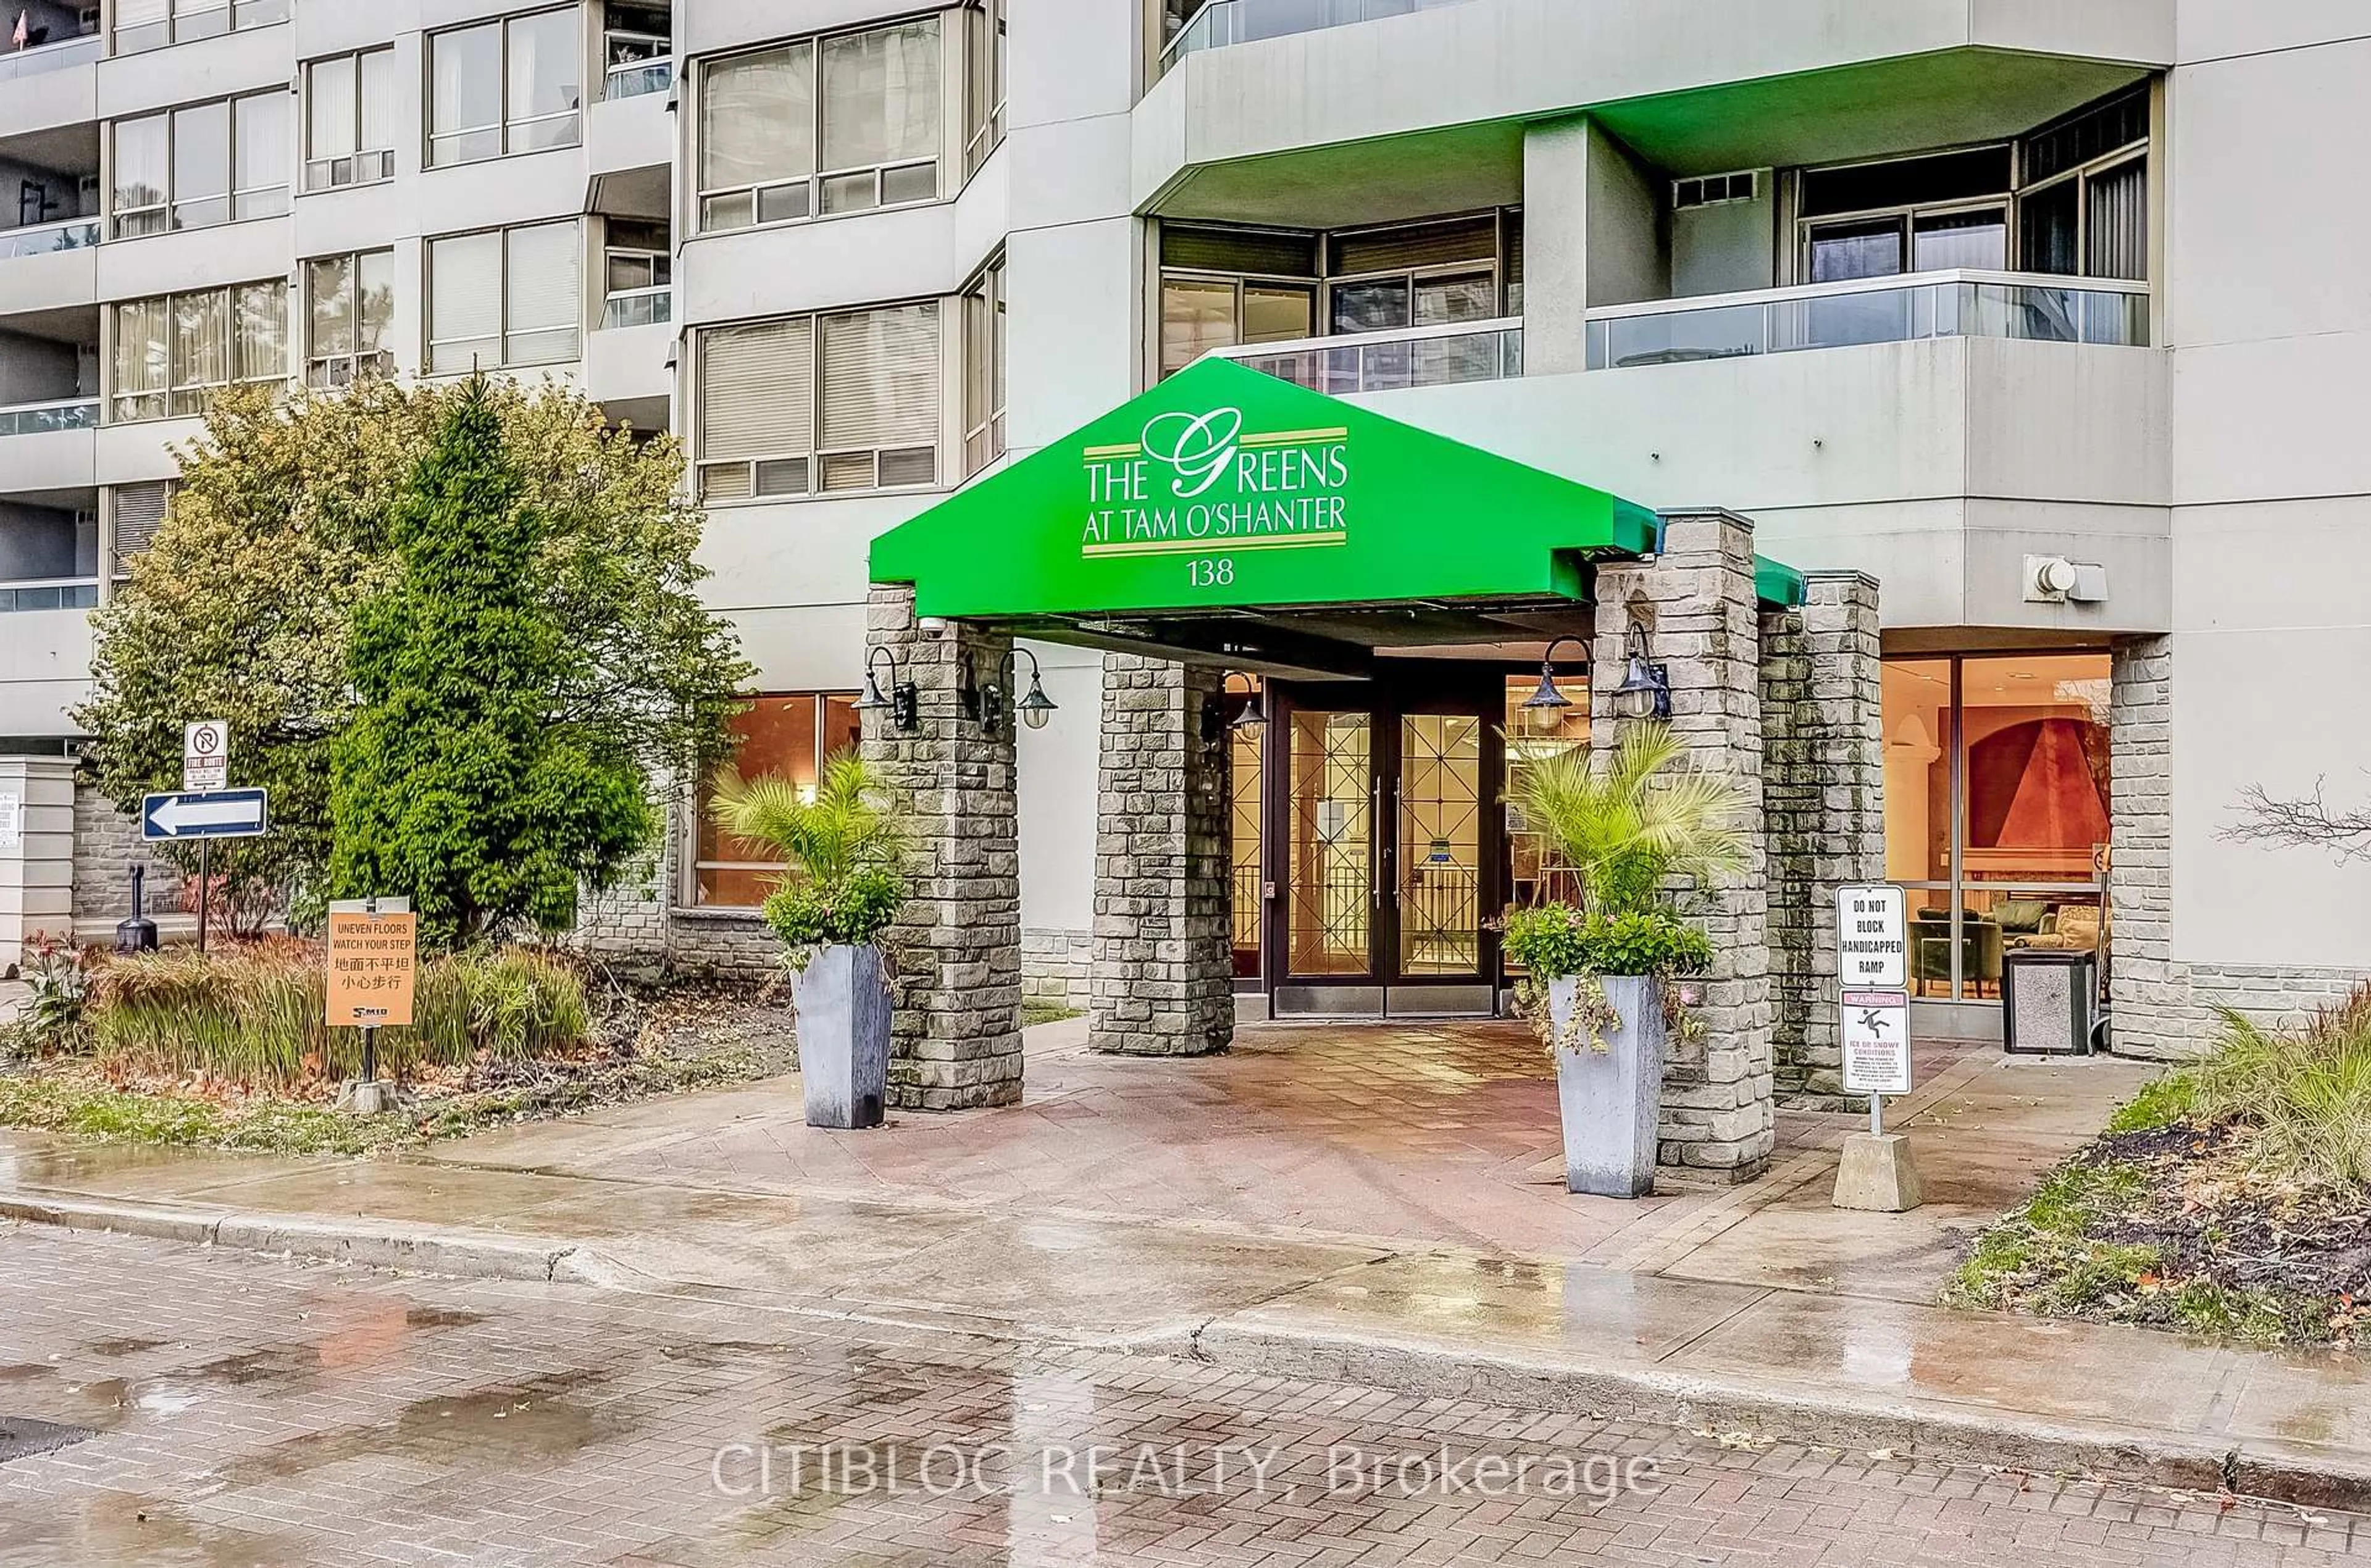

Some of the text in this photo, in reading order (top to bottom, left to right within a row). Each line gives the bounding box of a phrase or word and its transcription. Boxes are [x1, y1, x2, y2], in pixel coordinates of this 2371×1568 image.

[1084, 406, 1349, 504] THE GREENS
[1082, 496, 1347, 543] AT TAM O'SHANTER
[1186, 558, 1235, 587] 138
[1853, 900, 1886, 913] DO NOT
[338, 924, 408, 935] UNEVEN FLOORS
[1857, 920, 1884, 933] BLOCK
[333, 939, 411, 950] WATCH YOUR STEP
[1842, 940, 1903, 953] HANDICAPPED
[334, 957, 409, 972] 地面不平坦
[1859, 961, 1884, 974] RAMP
[341, 975, 402, 990] 小心步行
[1850, 995, 1897, 1004] WARNING
